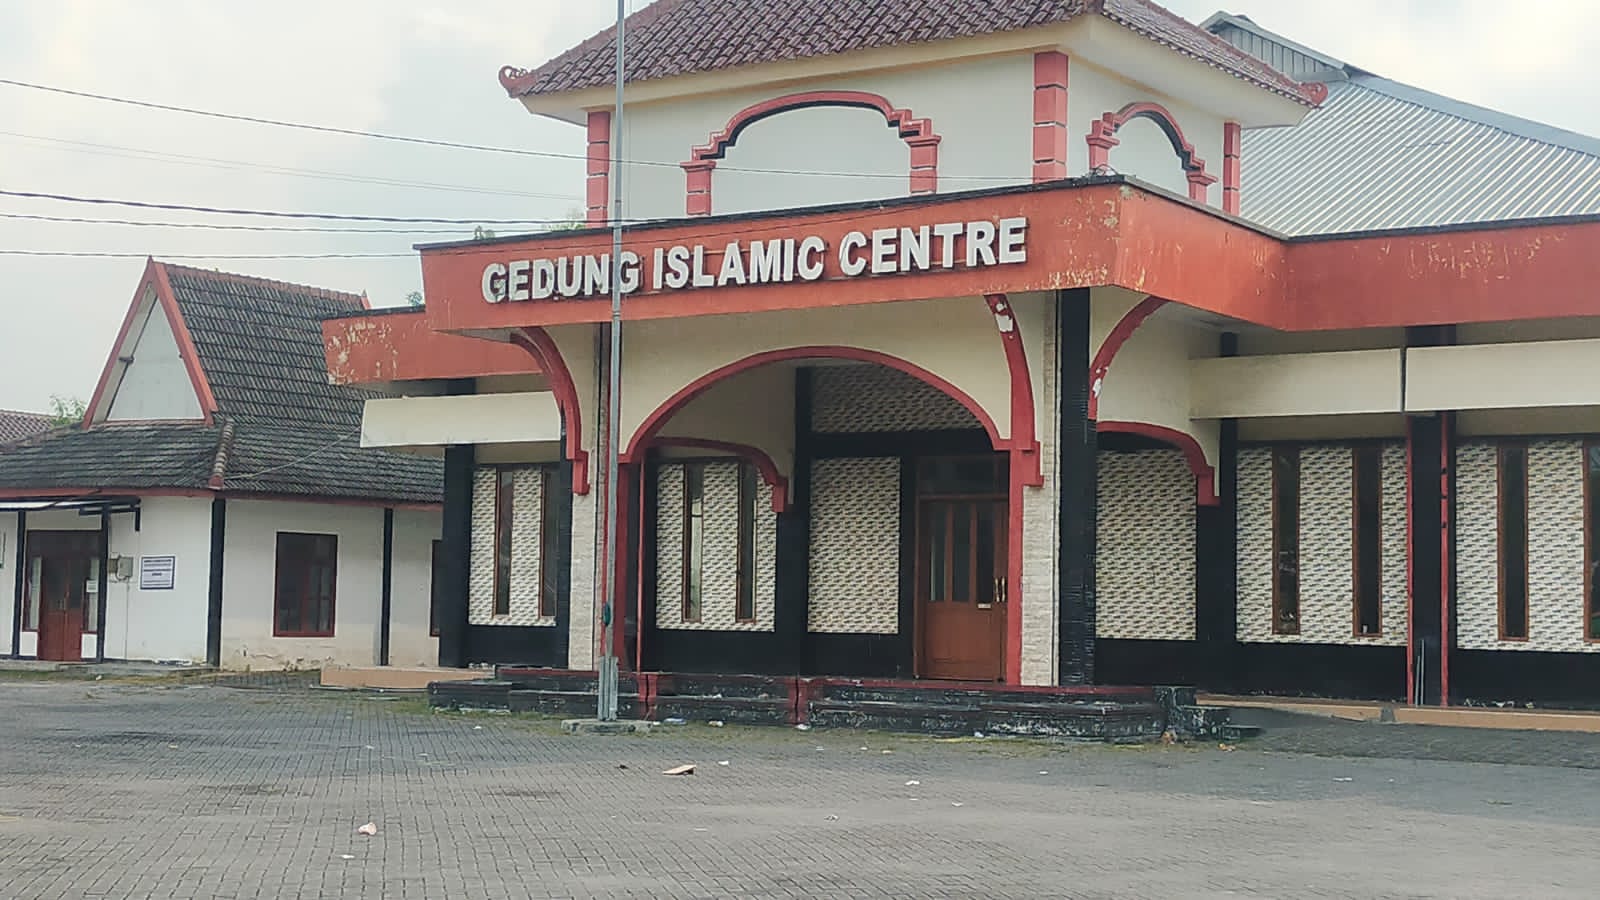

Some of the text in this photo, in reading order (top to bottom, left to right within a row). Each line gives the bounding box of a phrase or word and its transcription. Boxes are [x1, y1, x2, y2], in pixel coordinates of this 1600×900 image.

[481, 216, 1028, 304] GEDUNG ISLAMIC CENTRE
